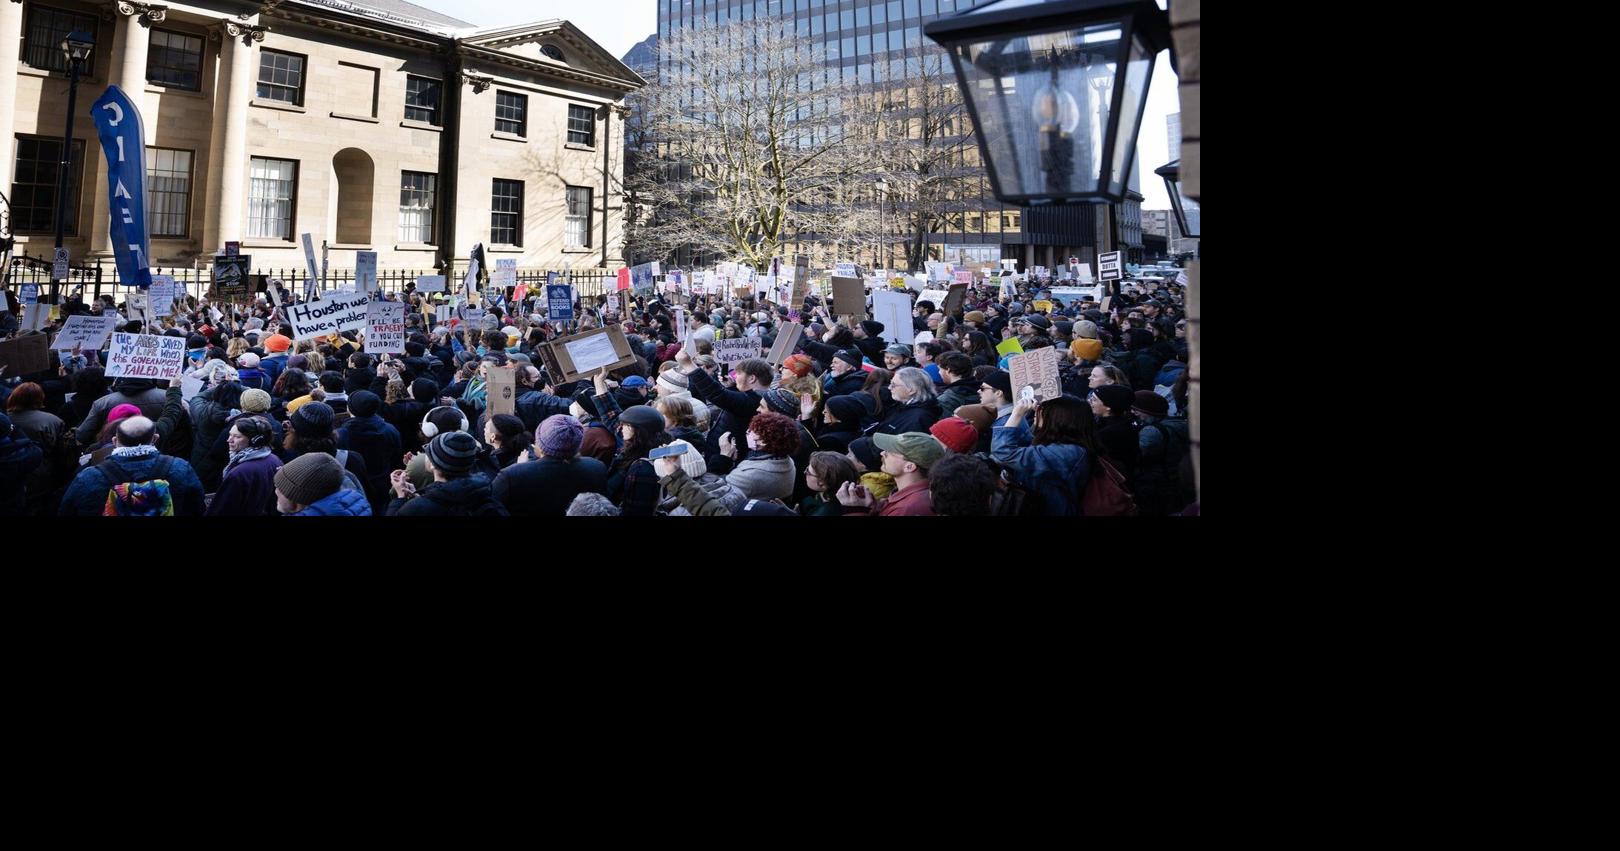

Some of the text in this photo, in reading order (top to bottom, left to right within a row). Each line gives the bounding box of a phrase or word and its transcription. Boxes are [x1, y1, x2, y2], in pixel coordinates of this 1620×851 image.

[293, 296, 369, 322] Houston we
[296, 321, 327, 336] have
[379, 332, 392, 340] YOU
[392, 332, 403, 340] CUT
[160, 338, 183, 350] SAVED
[369, 339, 401, 349] FUNDING
[123, 364, 180, 378] FAILED ME!
